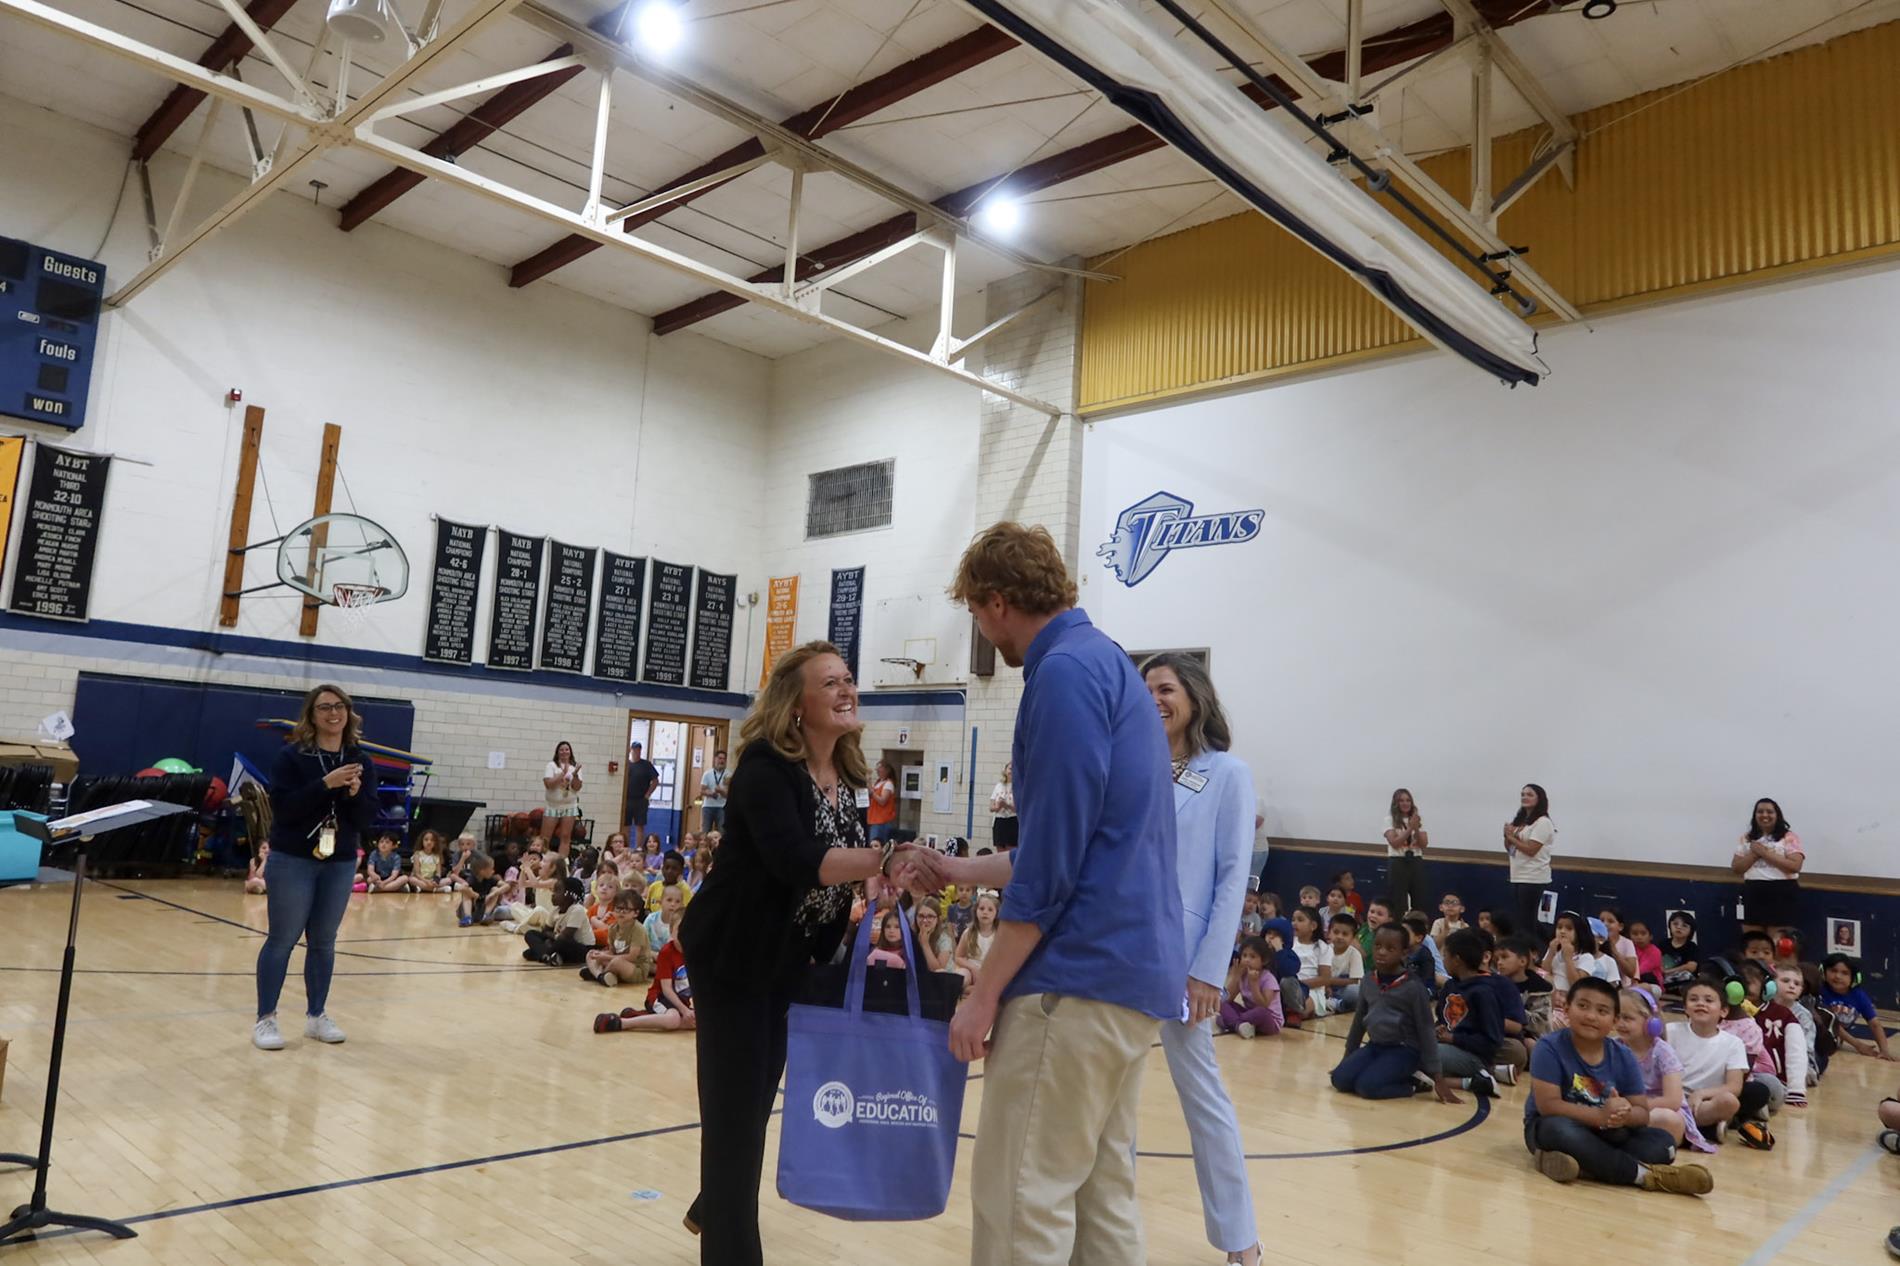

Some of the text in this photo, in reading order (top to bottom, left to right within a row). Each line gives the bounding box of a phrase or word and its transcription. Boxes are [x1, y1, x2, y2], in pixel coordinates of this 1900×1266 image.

[44, 256, 97, 284] Guests
[40, 339, 76, 360] fouls
[33, 398, 63, 414] won
[56, 454, 90, 470] AYBT
[53, 468, 87, 482] NATIONAL
[60, 480, 80, 491] THIRD
[54, 490, 82, 504] 32-10
[34, 500, 92, 518] MONMOUTH AREA
[32, 510, 67, 524] SHOOTING
[40, 532, 62, 540] JESSICA
[450, 526, 474, 538] NAYB
[449, 538, 472, 549] NATIONAL
[512, 537, 532, 549] NAYB
[445, 546, 472, 558] CHAMPIONS
[510, 550, 530, 560] NATIONAL
[562, 547, 584, 559] NAYB
[450, 557, 468, 569] 42-6
[508, 556, 532, 568] CHAMPIONS
[614, 558, 636, 568] AYBT
[463, 572, 476, 580] AREA
[664, 566, 683, 576] AYBT
[837, 570, 860, 580] AYBT
[25, 575, 53, 584] MICHELLE
[524, 581, 536, 589] AREA
[560, 575, 582, 587] 25-2
[36, 600, 63, 614] 1996
[440, 648, 458, 659] 1997
[503, 654, 520, 666] 1997
[554, 656, 572, 667] 1998
[607, 666, 624, 677] 1999
[656, 672, 672, 681] 1999
[702, 677, 716, 686] 1999
[856, 1102, 938, 1123] EDUCATION
